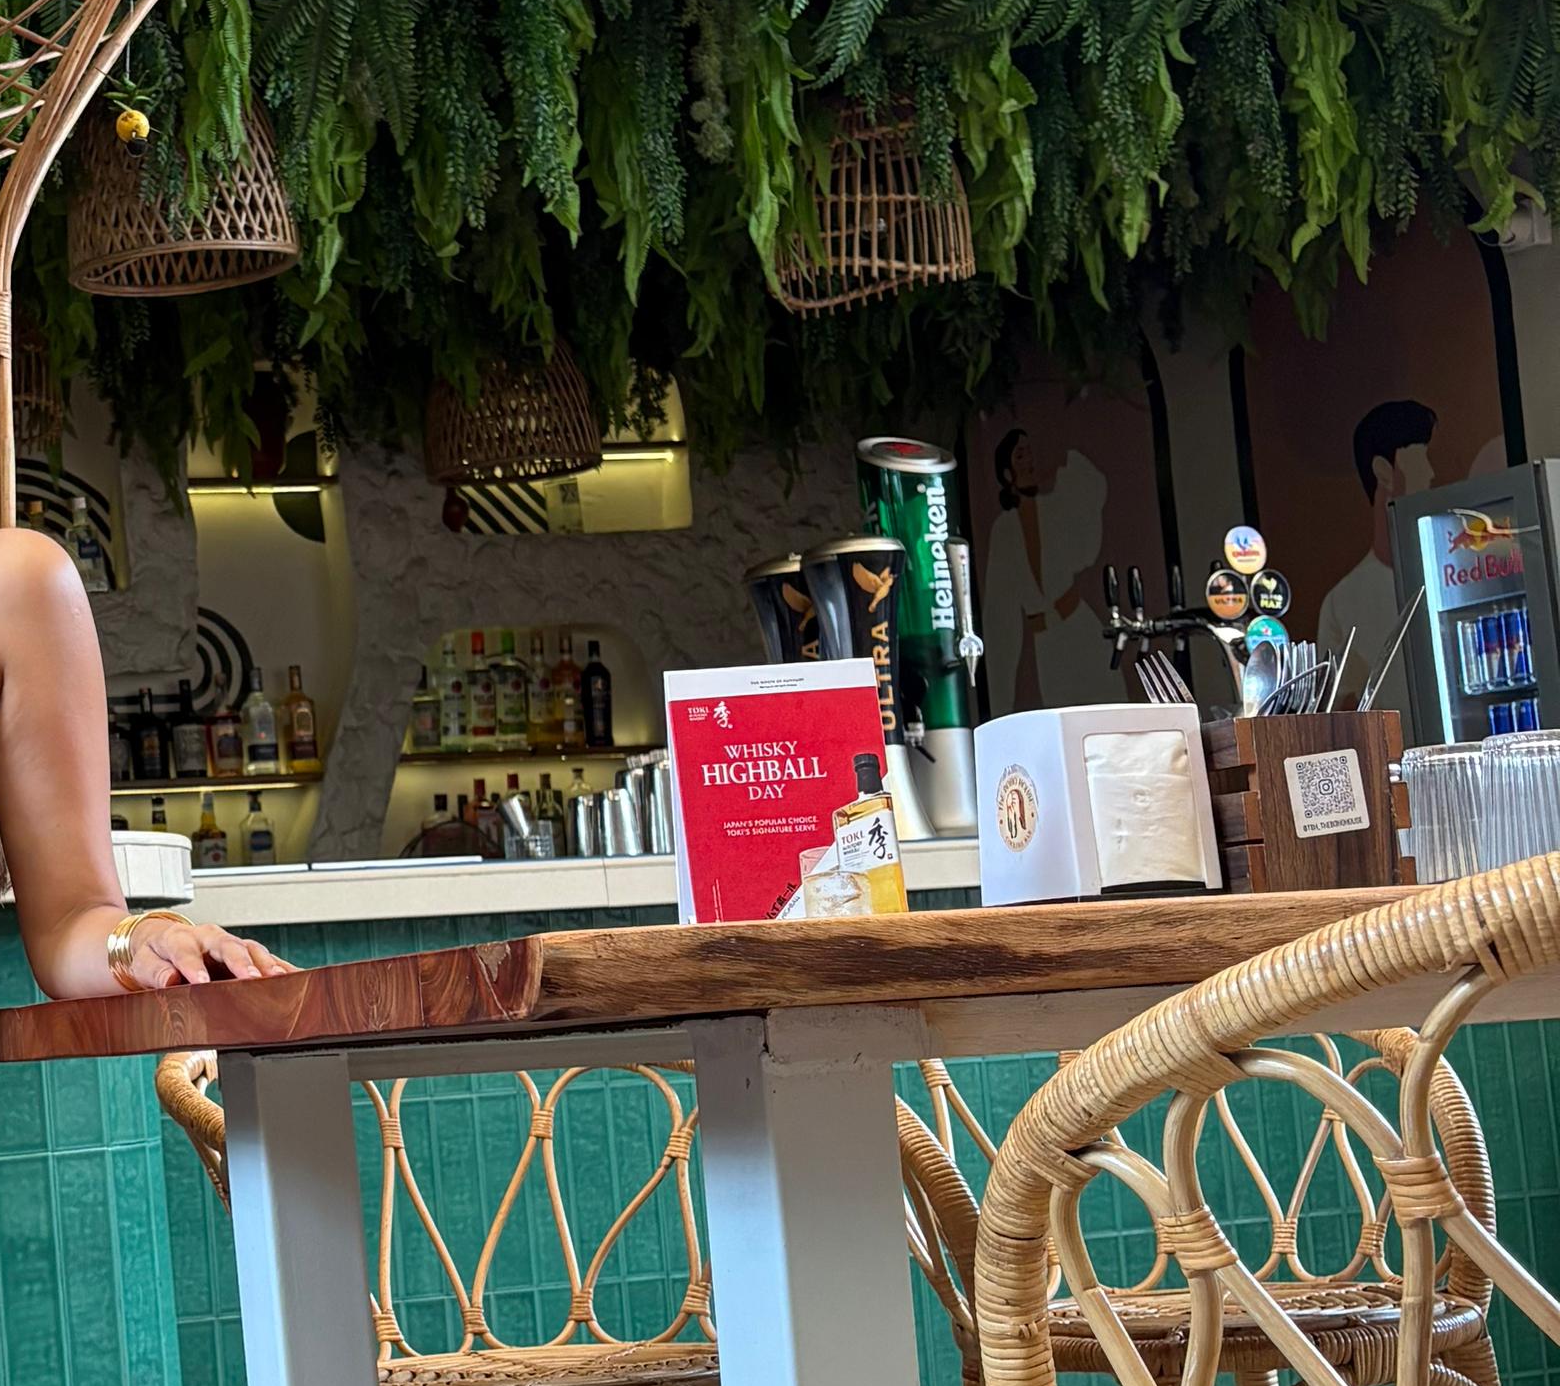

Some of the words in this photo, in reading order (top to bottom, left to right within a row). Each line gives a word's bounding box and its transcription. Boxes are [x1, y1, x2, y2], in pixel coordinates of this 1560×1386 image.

[924, 480, 955, 631] Heineken
[1443, 556, 1482, 587] Red
[870, 621, 897, 731] ULTRA
[688, 706, 710, 715] TOKI
[724, 741, 798, 760] WHISKY
[701, 756, 828, 786] HIGHBALL
[747, 783, 786, 801] DAY
[723, 819, 753, 830] JAPAN'S
[754, 816, 787, 827] POPULAR
[787, 815, 819, 825] CHOICE.
[727, 828, 751, 837] TOKI'S
[752, 825, 793, 835] SIGNATURE
[794, 824, 818, 832] SERVE.
[842, 830, 865, 844] TOKI
